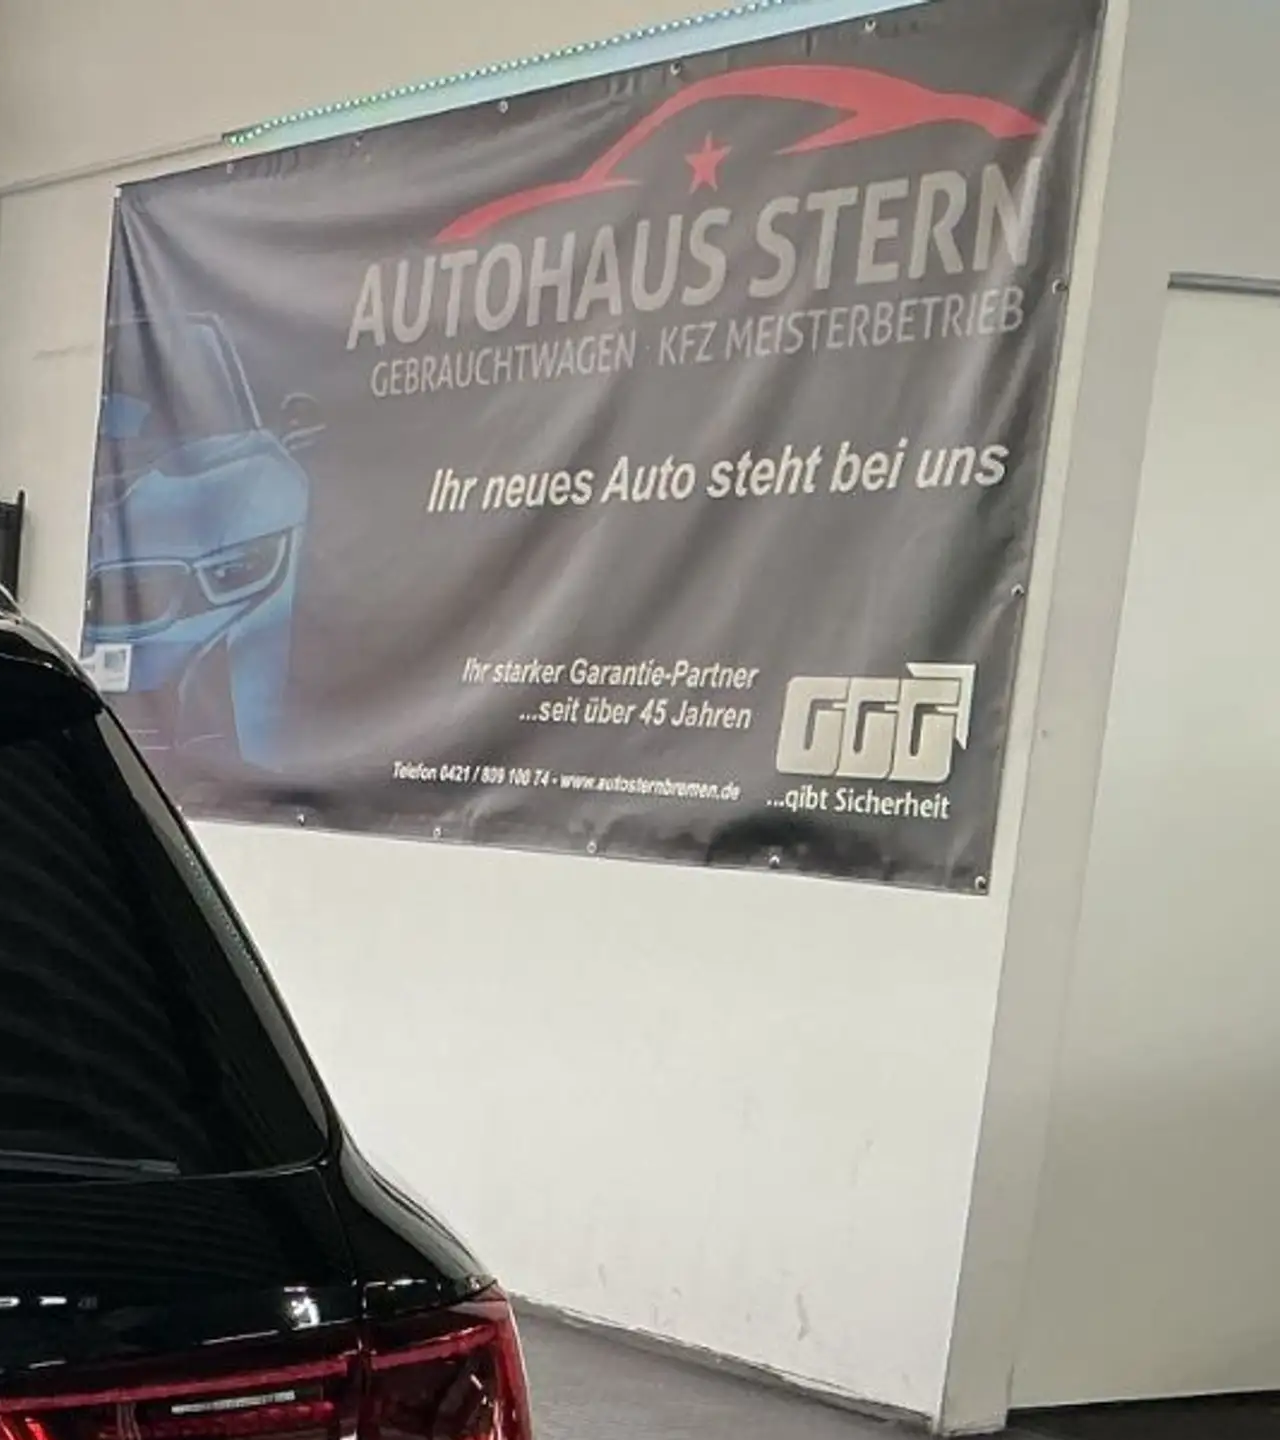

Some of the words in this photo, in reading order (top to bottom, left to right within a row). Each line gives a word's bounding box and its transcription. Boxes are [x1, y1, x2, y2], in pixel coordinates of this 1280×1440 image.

[346, 207, 732, 351] AUTOHAUS
[749, 156, 1042, 298] STERN
[371, 328, 637, 398] GEBRAUCHTWAGEN
[659, 321, 718, 366] KFZ
[725, 286, 1026, 360] MEISTERBETRIEB
[427, 467, 478, 513] Ihr
[481, 467, 593, 511] neues
[601, 455, 695, 504] Auto
[706, 445, 822, 498] steht
[830, 438, 907, 492] bei
[915, 442, 1009, 488] uns
[461, 657, 490, 683] Ihr
[492, 658, 561, 684] starker
[569, 658, 760, 689] Garantie-Partner
[583, 697, 636, 725] über
[639, 699, 667, 726] 45
[670, 699, 753, 729] Jahren
[392, 760, 438, 781] Telefon
[560, 773, 740, 800] www.autosternbremen.de
[834, 788, 952, 819] Sicherheit
